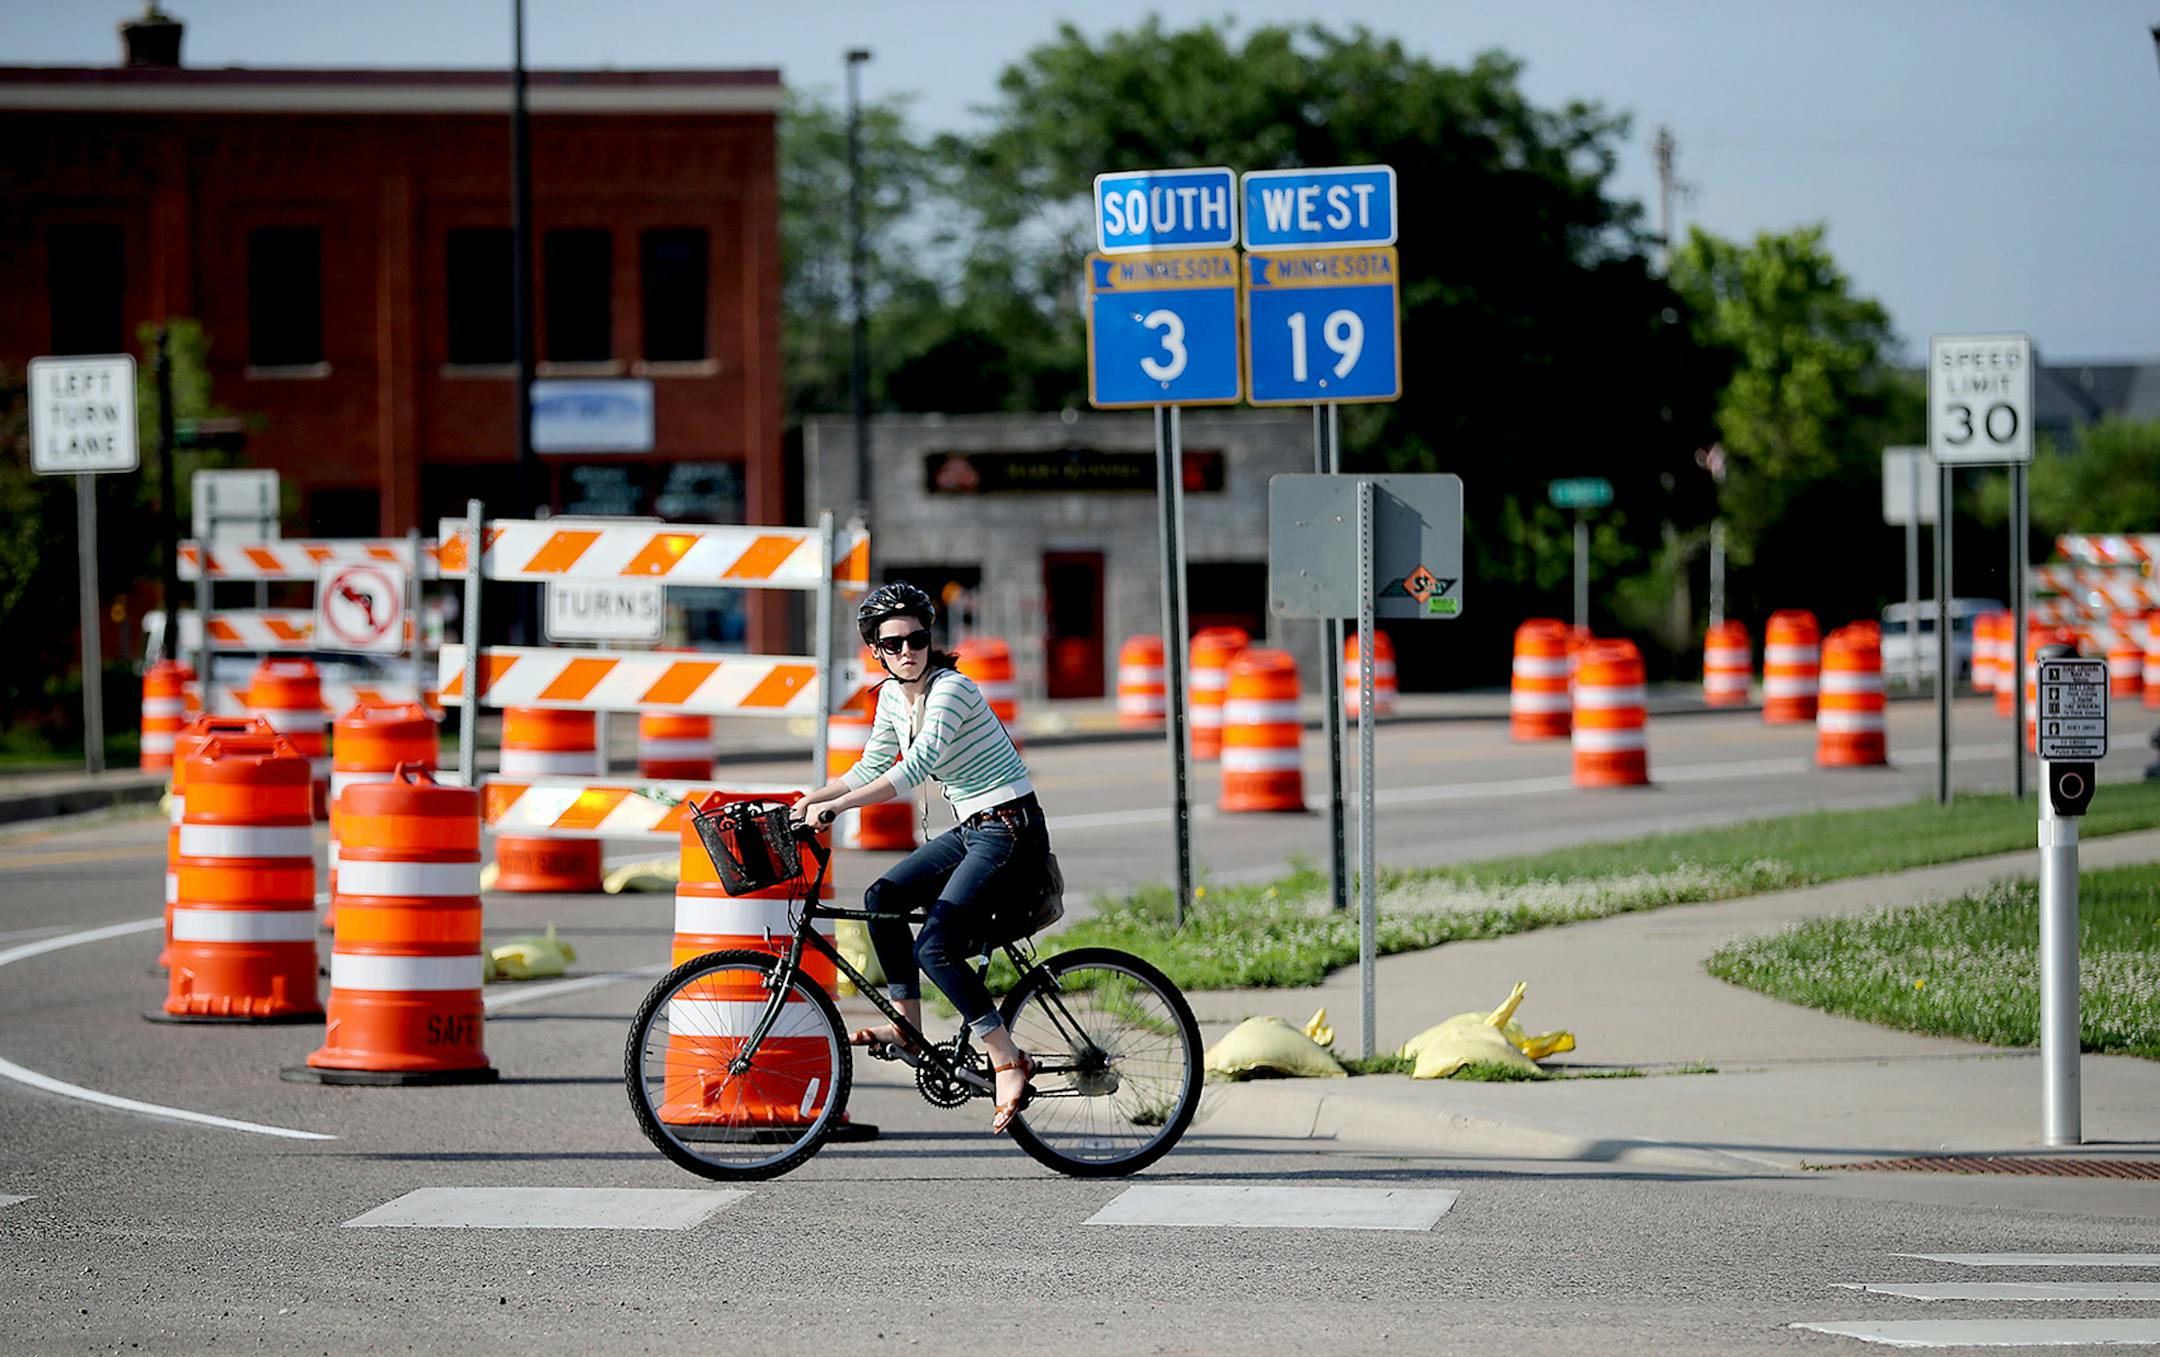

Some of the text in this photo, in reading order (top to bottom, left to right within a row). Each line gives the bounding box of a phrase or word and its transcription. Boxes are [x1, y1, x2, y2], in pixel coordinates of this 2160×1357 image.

[1104, 186, 1227, 236] SOUTH
[1262, 184, 1375, 232] WEST
[1120, 256, 1233, 281] MINNESOTA
[1277, 255, 1392, 278] MINNESOTA
[1140, 309, 1188, 382] 3
[1287, 309, 1365, 382] 19
[1941, 347, 2021, 371] SPEED
[50, 370, 113, 398] LEFT
[1946, 375, 2010, 397] LIMIT
[50, 402, 119, 428] TURN
[1944, 402, 2018, 445] 30
[48, 433, 118, 460] LANE
[557, 589, 657, 619] TURNS
